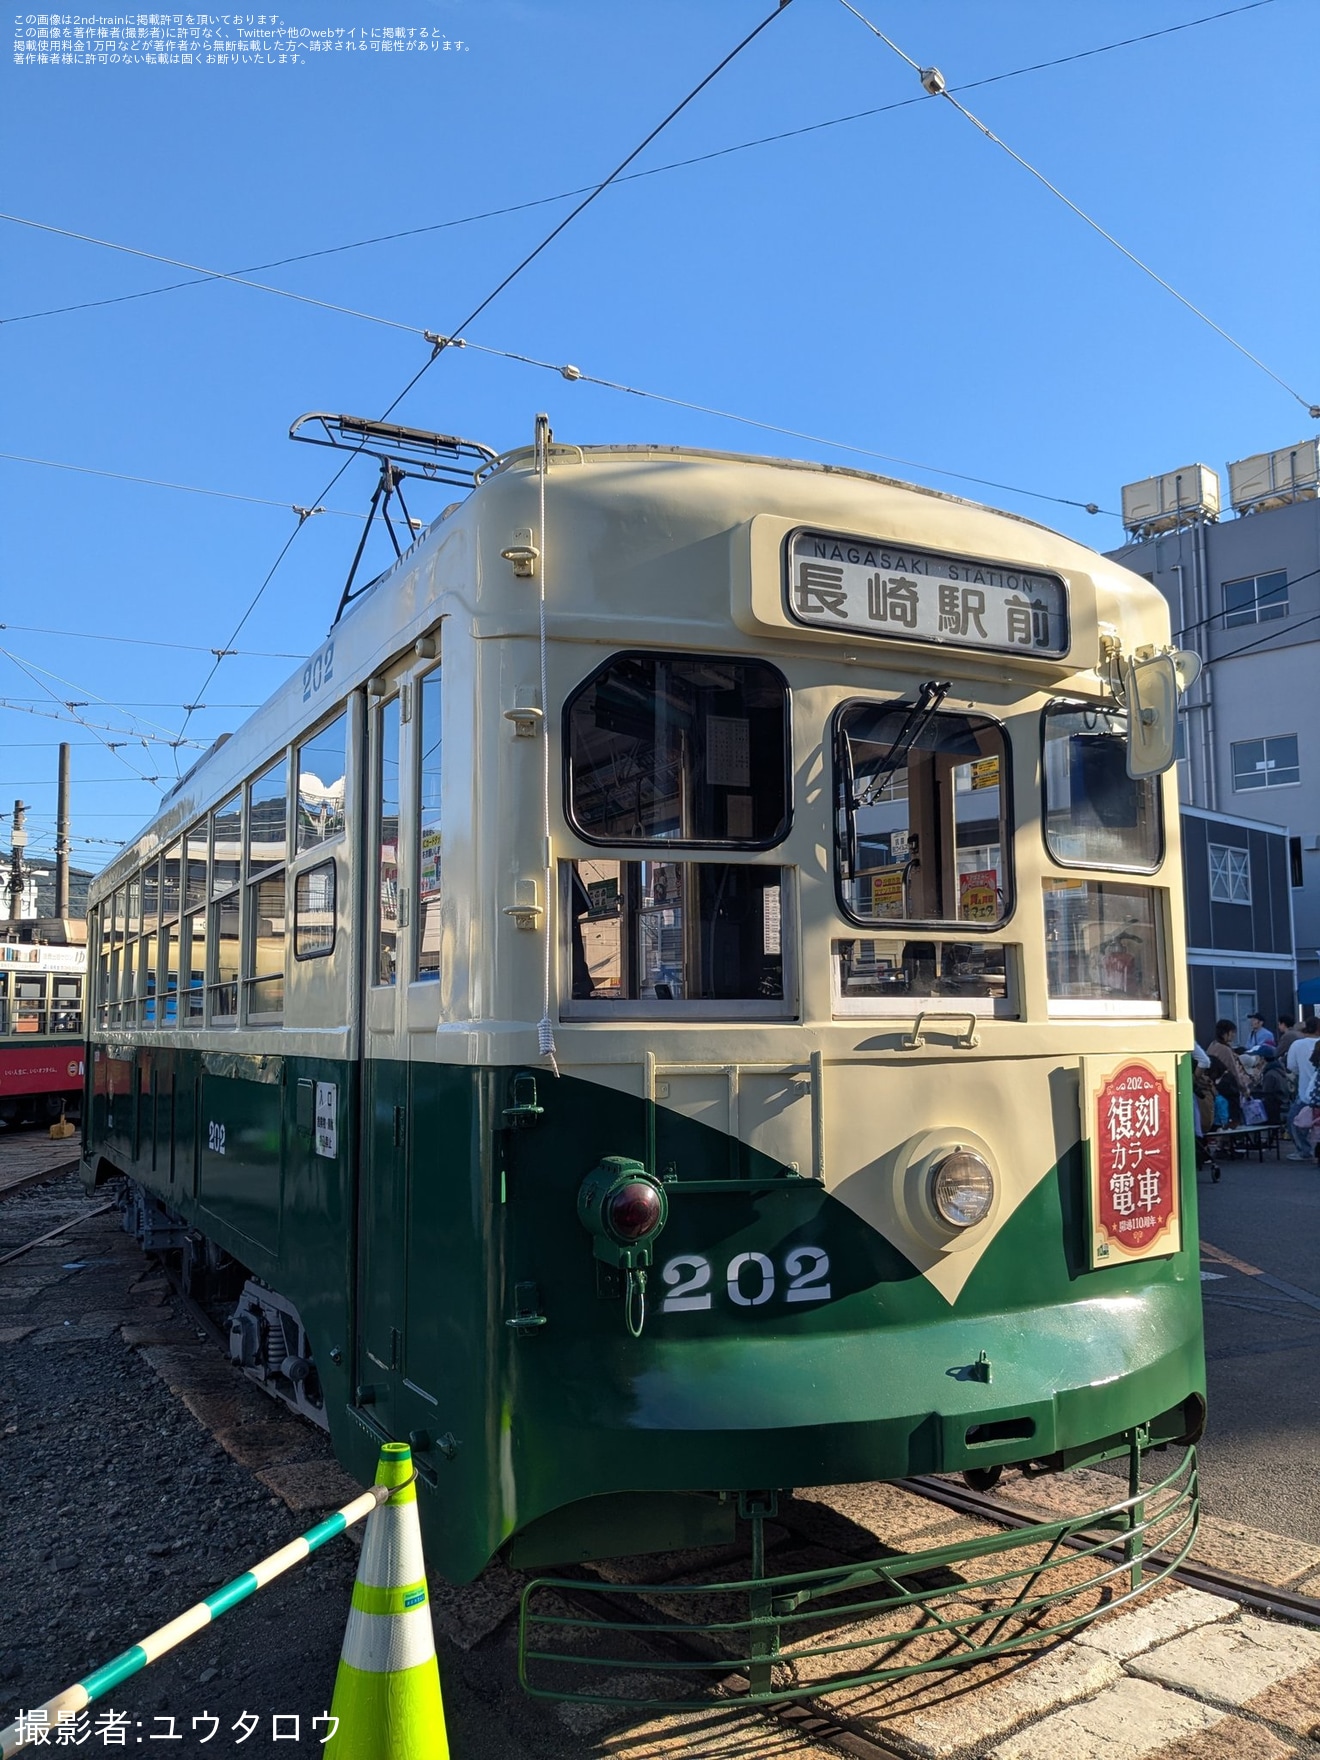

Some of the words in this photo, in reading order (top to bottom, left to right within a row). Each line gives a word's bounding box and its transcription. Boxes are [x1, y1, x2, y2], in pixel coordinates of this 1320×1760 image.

[814, 541, 929, 576] NAGASAKI
[948, 566, 1033, 592] STATION
[795, 562, 1050, 647] 長崎駅前
[303, 642, 334, 703] 202
[319, 1089, 332, 1107] 入口
[1126, 1077, 1143, 1090] 202
[209, 1120, 226, 1155] 202
[1108, 1093, 1159, 1141] 復刻
[1111, 1142, 1160, 1170] カラー
[1110, 1168, 1161, 1216] 電車
[662, 1247, 831, 1312] 202
